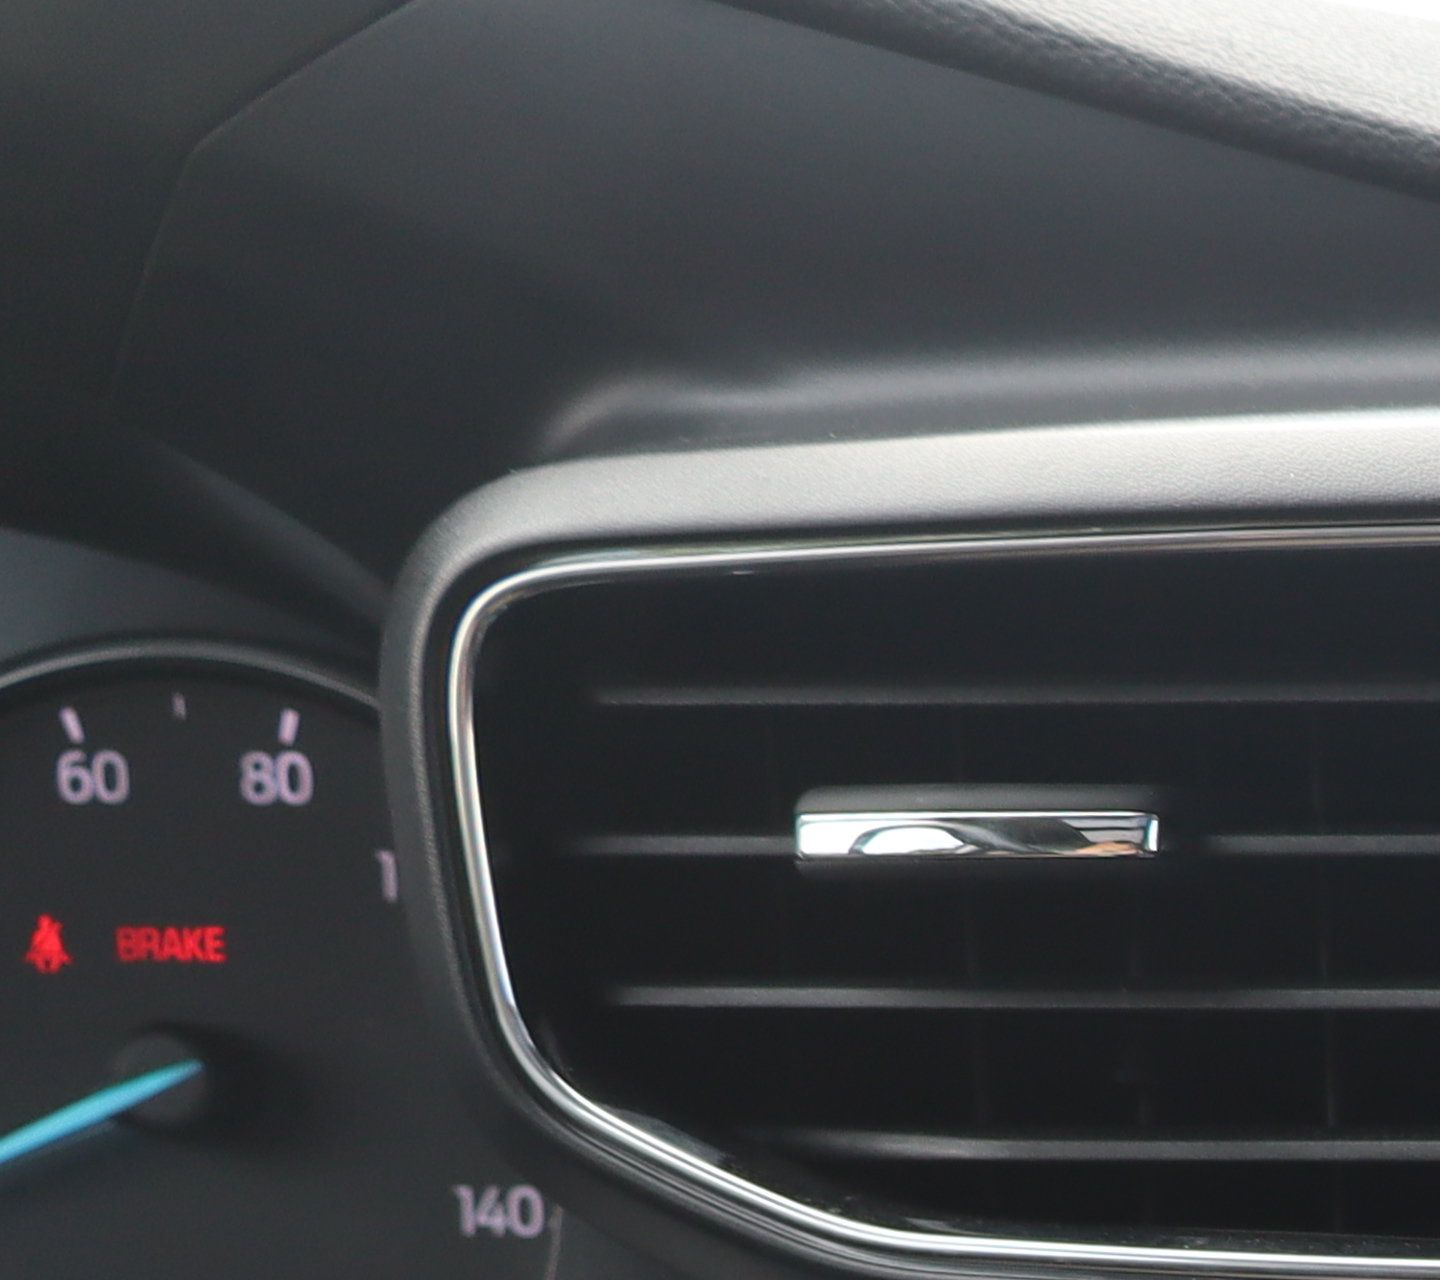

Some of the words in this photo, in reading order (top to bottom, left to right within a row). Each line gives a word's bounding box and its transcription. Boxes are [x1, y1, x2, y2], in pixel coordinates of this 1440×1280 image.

[56, 752, 130, 806] 60
[239, 751, 314, 807] 80
[115, 926, 227, 964] BRAKE
[454, 1186, 546, 1239] 140
